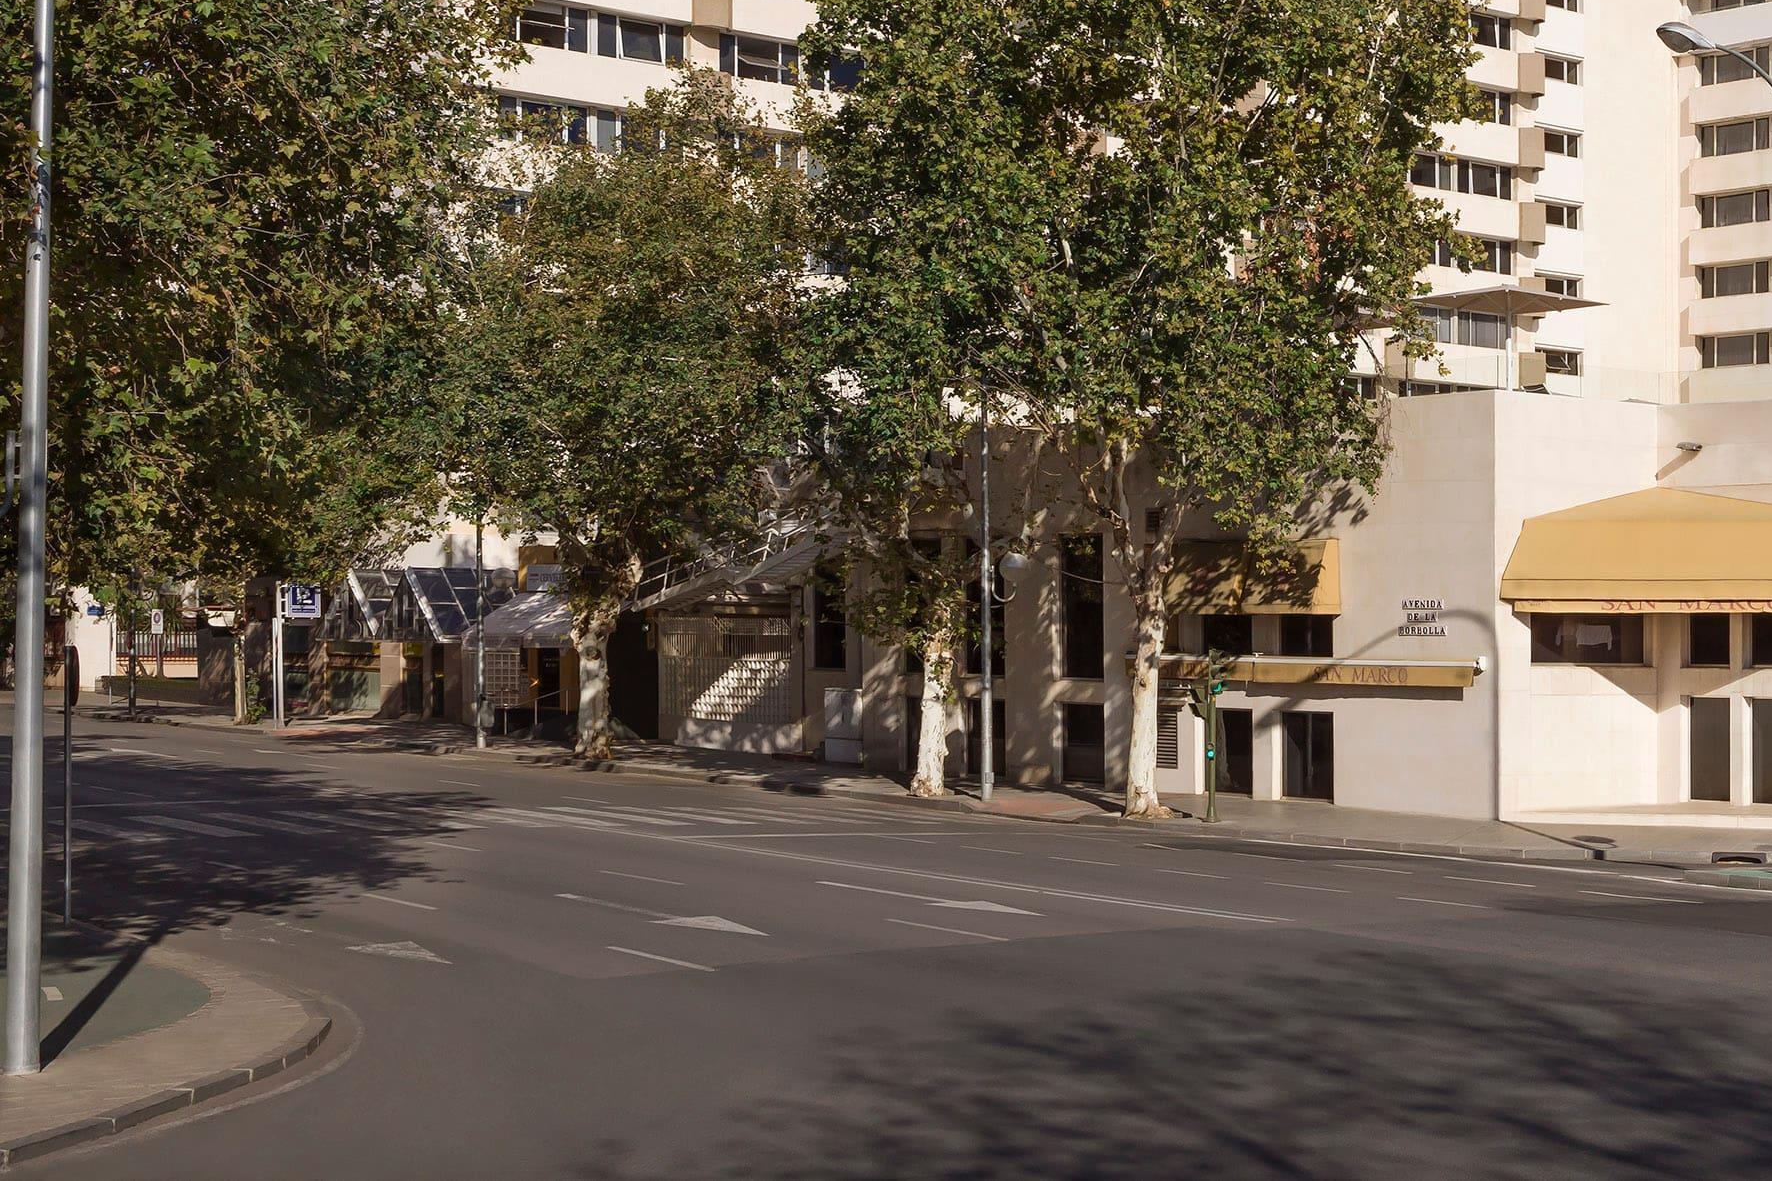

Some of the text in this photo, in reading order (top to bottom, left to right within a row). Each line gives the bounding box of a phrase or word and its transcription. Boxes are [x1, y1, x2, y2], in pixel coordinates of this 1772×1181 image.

[1402, 600, 1442, 608] AVENIDA
[1408, 613, 1436, 621] DE LA
[1399, 626, 1446, 635] BORBOLLA
[1313, 666, 1408, 684] SAN MARCO
